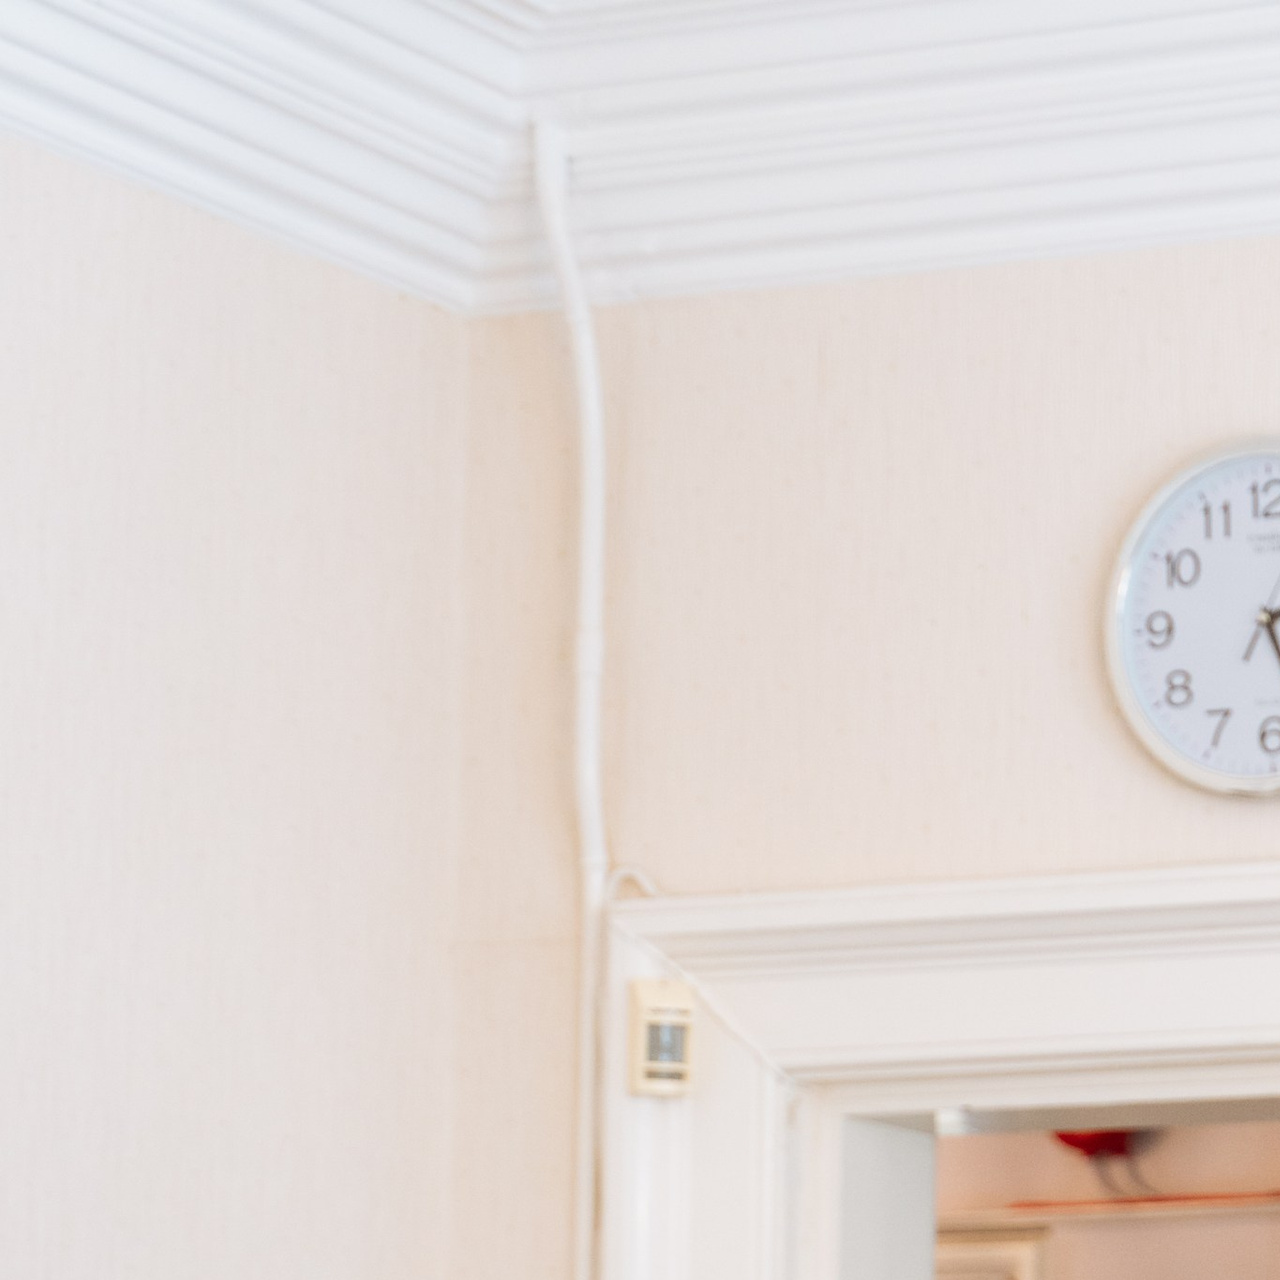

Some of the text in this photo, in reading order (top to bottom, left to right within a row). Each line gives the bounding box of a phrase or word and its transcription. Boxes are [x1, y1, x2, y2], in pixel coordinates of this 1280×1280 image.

[1202, 500, 1232, 539] 11
[1164, 548, 1201, 588] 10
[1146, 612, 1174, 648] 9
[1166, 670, 1193, 707] 8
[1207, 709, 1231, 746] 7
